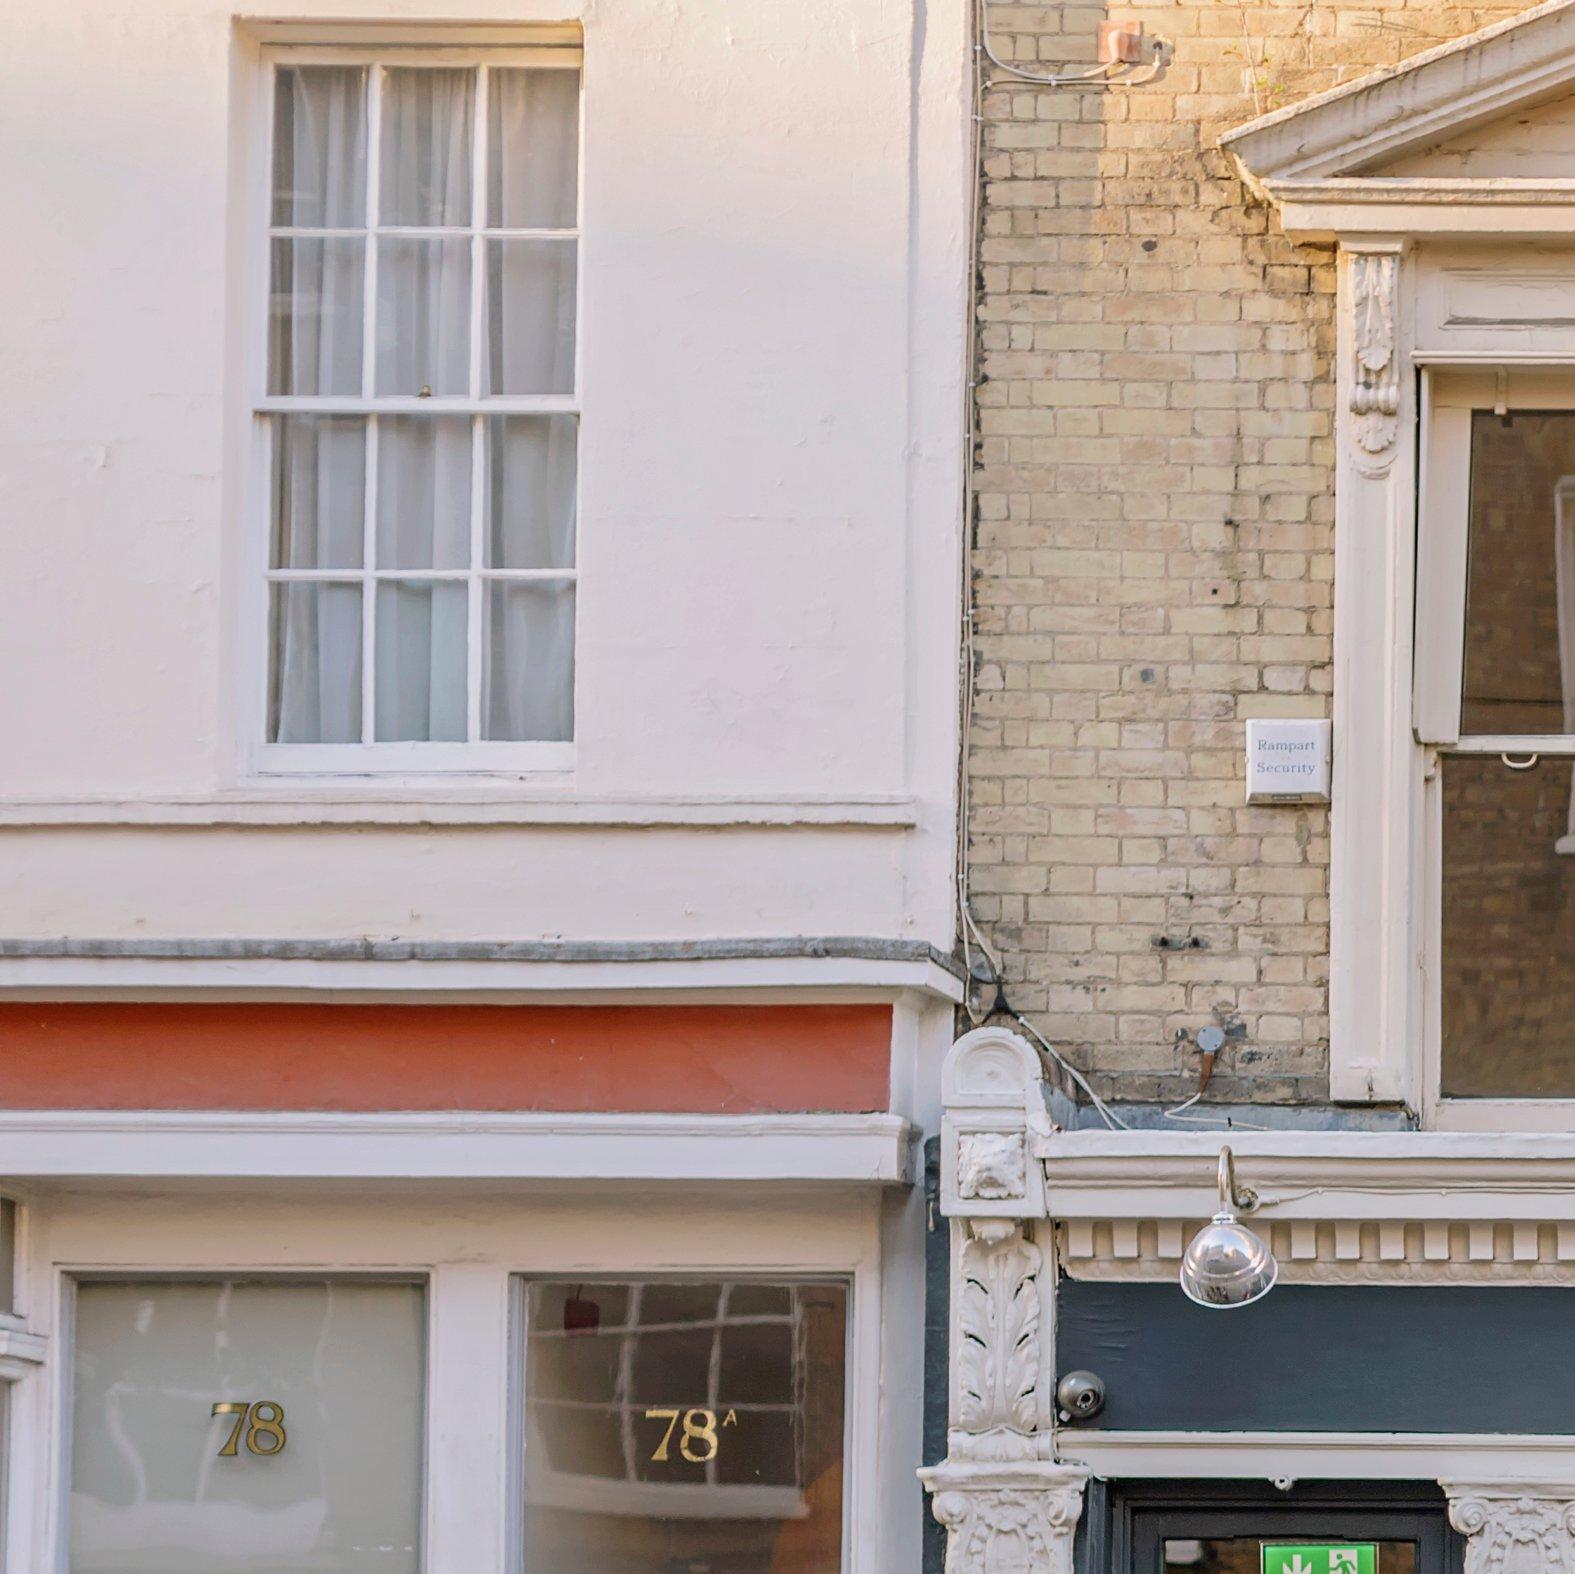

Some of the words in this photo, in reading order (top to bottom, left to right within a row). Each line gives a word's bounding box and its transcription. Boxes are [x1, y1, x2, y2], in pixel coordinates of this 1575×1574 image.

[1258, 739, 1315, 753] Rampart
[1256, 761, 1316, 776] Security
[211, 1400, 287, 1457] 78
